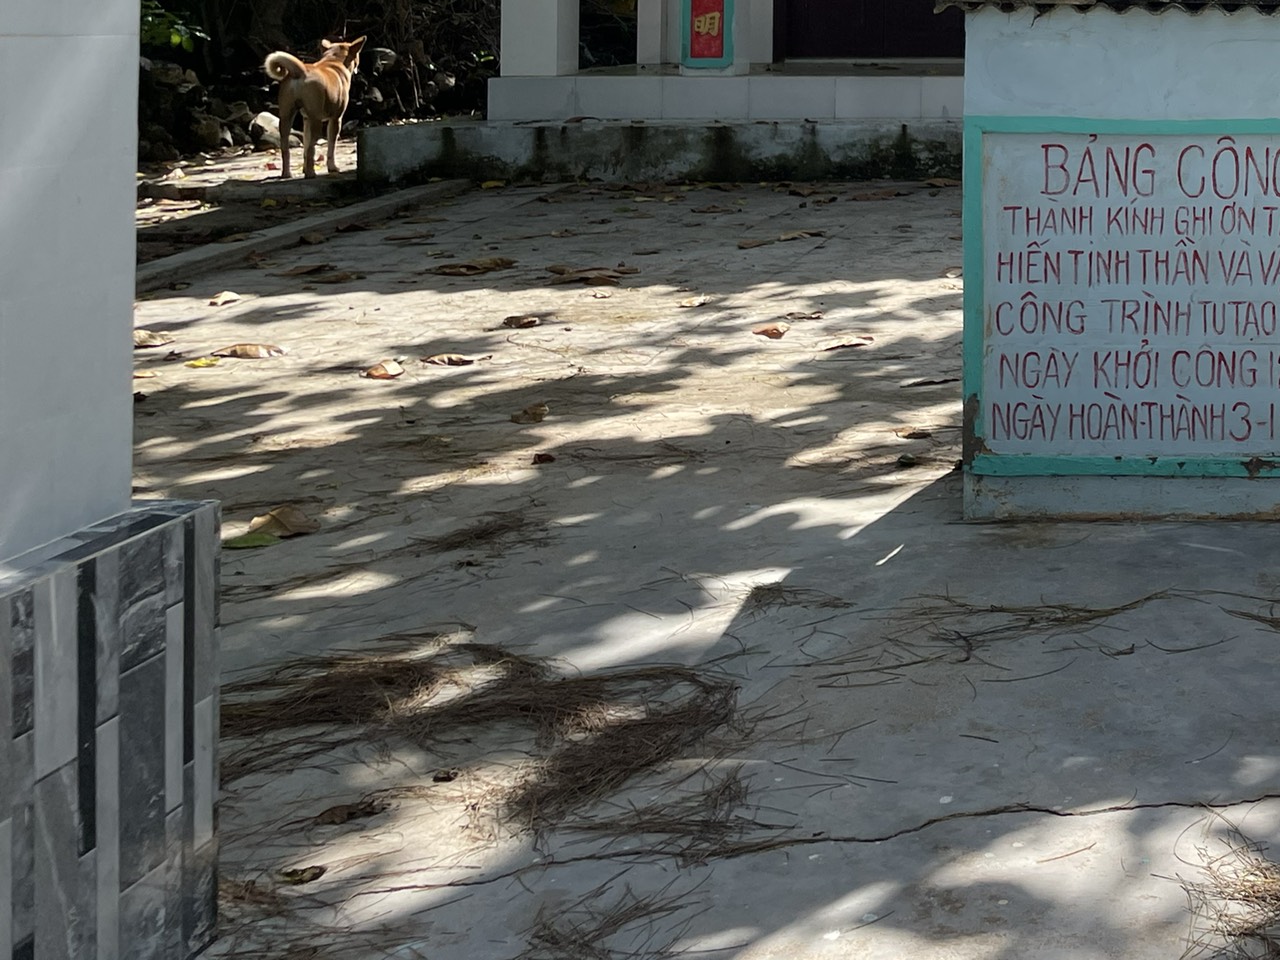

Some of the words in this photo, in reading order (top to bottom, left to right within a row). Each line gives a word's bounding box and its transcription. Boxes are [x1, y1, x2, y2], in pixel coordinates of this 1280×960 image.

[1040, 134, 1156, 198] BẢNG
[1003, 197, 1094, 237] THÀNH
[1106, 197, 1165, 236] KÍNH
[1174, 205, 1213, 236] GHI
[1219, 201, 1256, 236] ƠN
[997, 238, 1062, 285] HIẾN
[1136, 236, 1210, 286] THẦN
[1218, 238, 1253, 287] VÀ
[995, 290, 1088, 337] CÔNG
[1100, 289, 1192, 337] TRÌNH
[1000, 346, 1079, 390] NGÀY
[1093, 339, 1160, 390] KHỞI
[1171, 342, 1258, 389] CÔNG
[991, 393, 1063, 442] NGÀY
